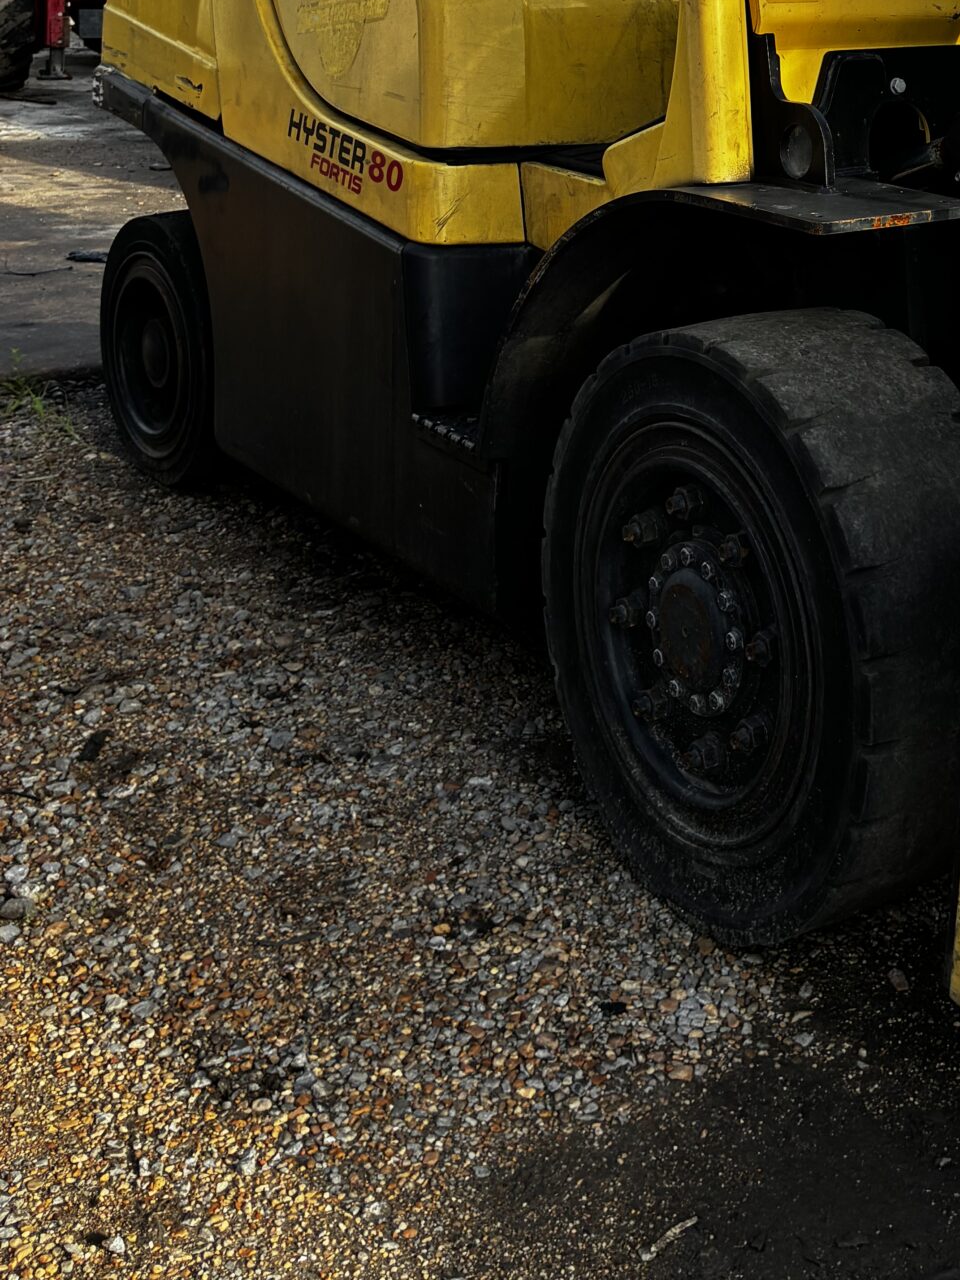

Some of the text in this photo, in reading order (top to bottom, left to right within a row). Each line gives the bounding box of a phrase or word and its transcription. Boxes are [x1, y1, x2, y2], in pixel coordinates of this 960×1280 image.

[287, 108, 404, 192] HYSTER 80
[310, 152, 363, 195] FORTIS
